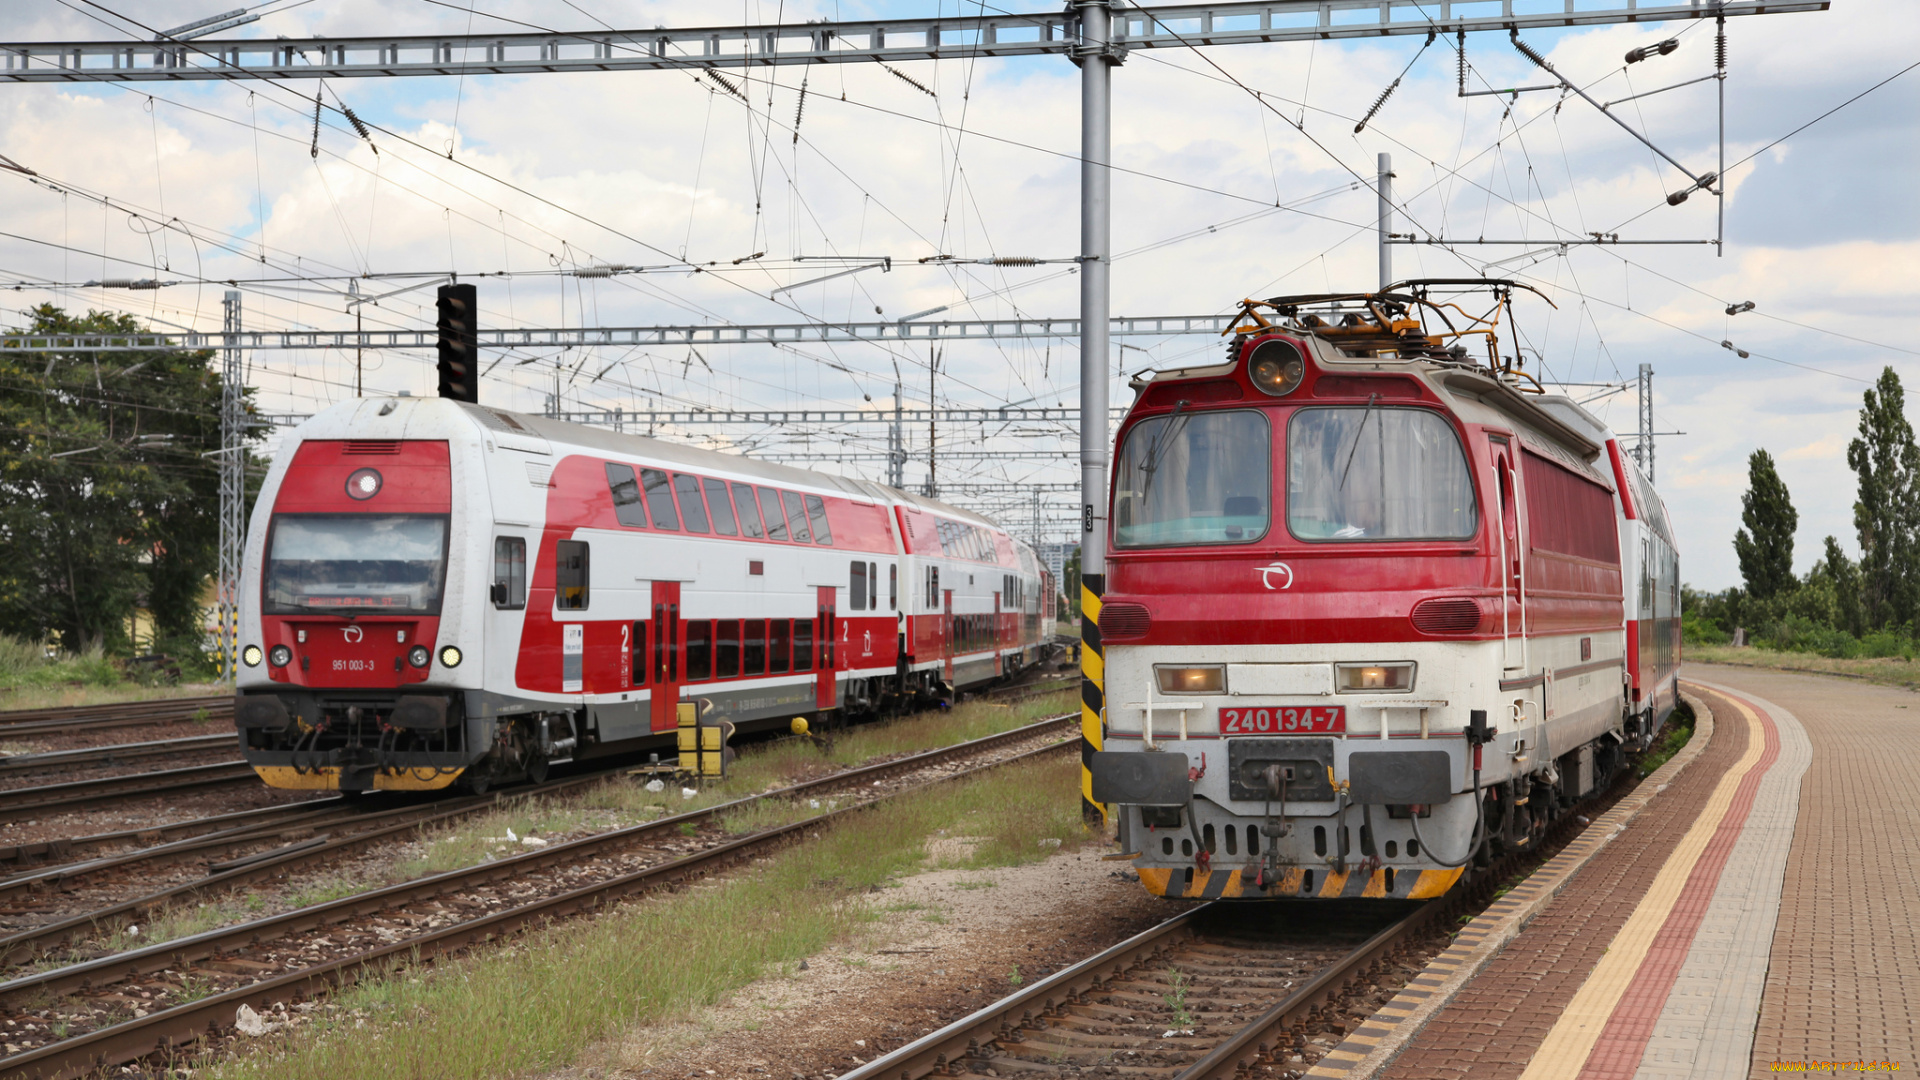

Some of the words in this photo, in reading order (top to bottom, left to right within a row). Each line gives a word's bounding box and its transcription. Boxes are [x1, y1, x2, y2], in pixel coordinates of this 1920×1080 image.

[1086, 507, 1092, 529] 33
[621, 624, 629, 653] 2
[843, 620, 849, 642] 2
[332, 659, 349, 671] 951
[1225, 709, 1270, 732] 240
[1275, 708, 1339, 730] 134-7
